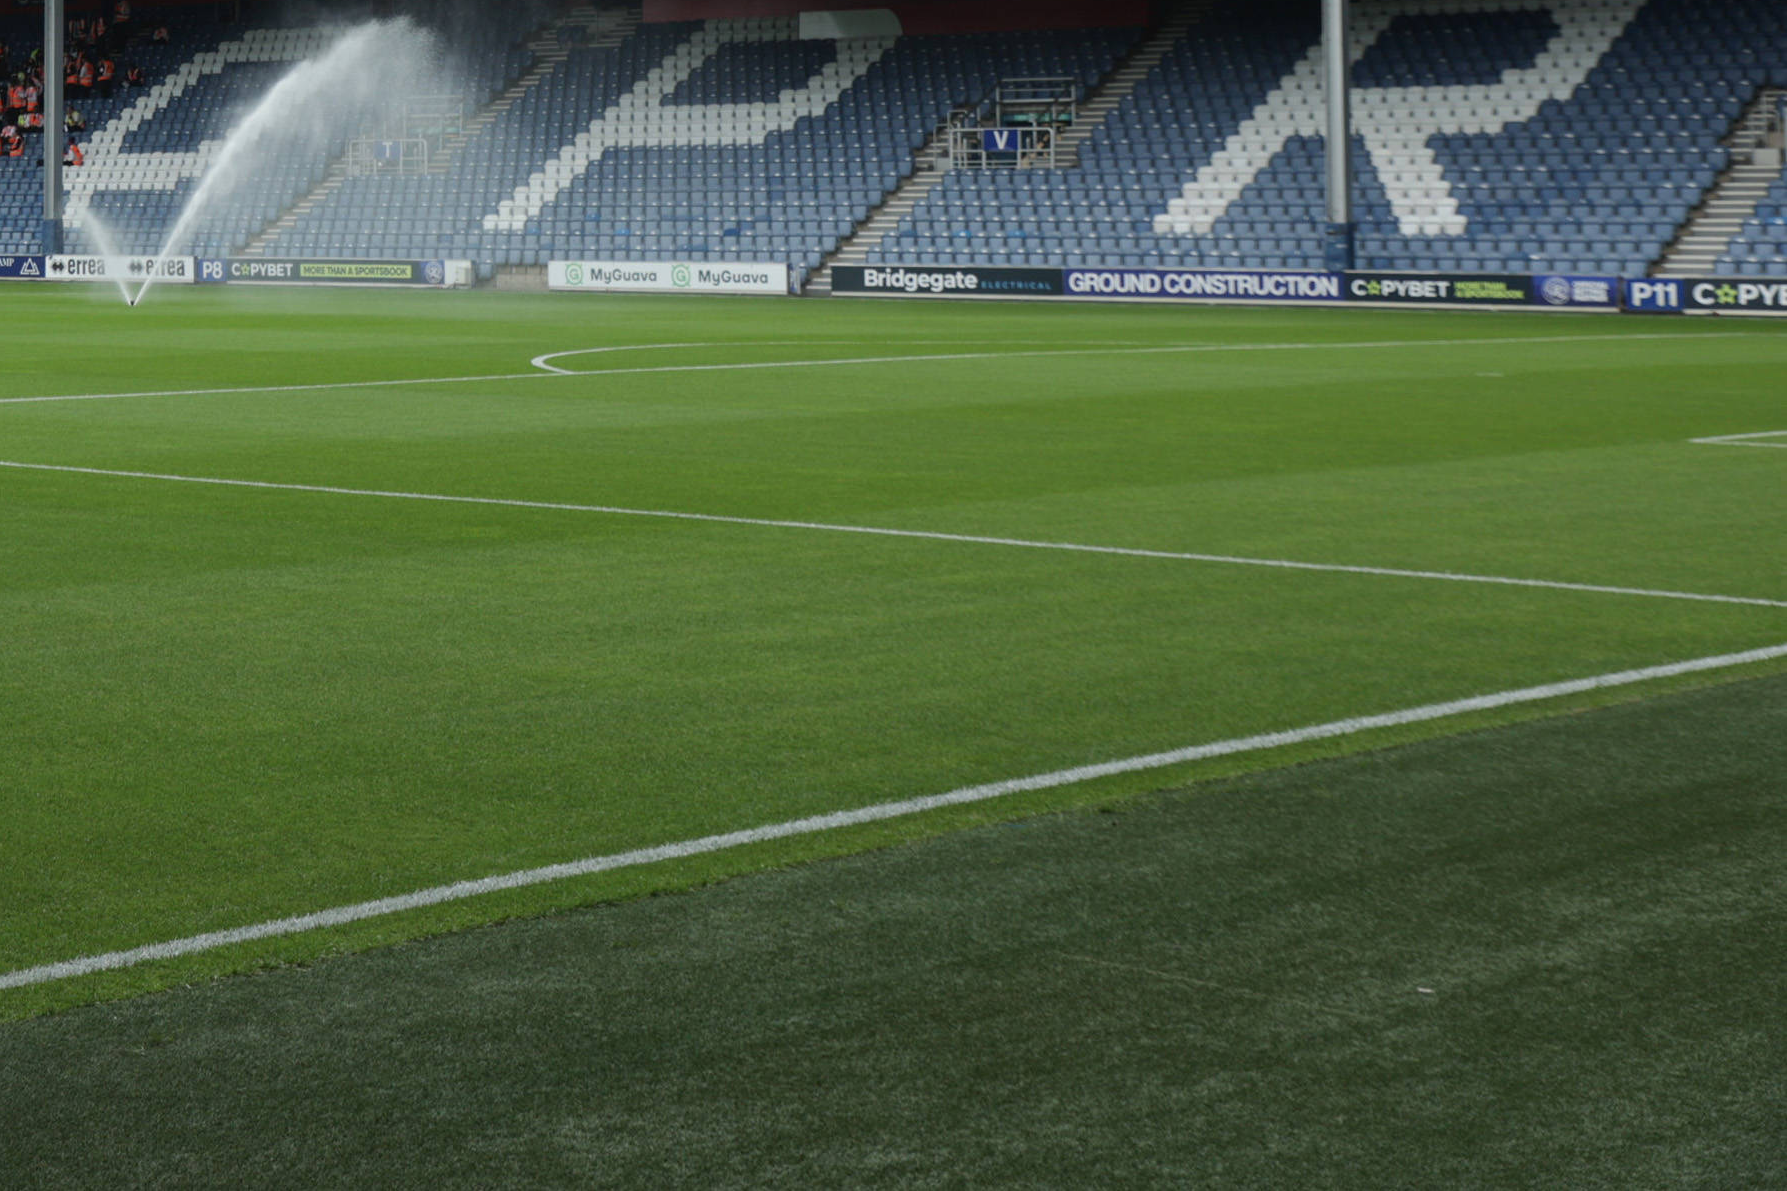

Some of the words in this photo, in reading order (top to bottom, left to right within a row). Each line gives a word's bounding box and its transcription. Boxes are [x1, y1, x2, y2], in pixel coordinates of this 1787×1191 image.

[993, 130, 1009, 150] V
[381, 141, 393, 158] T
[67, 258, 105, 276] errea
[202, 261, 223, 279] P8
[303, 265, 326, 275] MORE
[327, 266, 346, 276] THAN
[347, 266, 353, 276] A
[354, 266, 409, 277] SPORTSBOOK
[590, 268, 658, 284] MyGuava
[698, 269, 769, 286] MyGuava
[864, 268, 978, 293] Bridgegate
[981, 280, 1052, 290] ELECTRICAL
[1068, 272, 1161, 294] GROUND
[1163, 274, 1339, 297] CONSTRUCTION
[1630, 281, 1678, 307] P11
